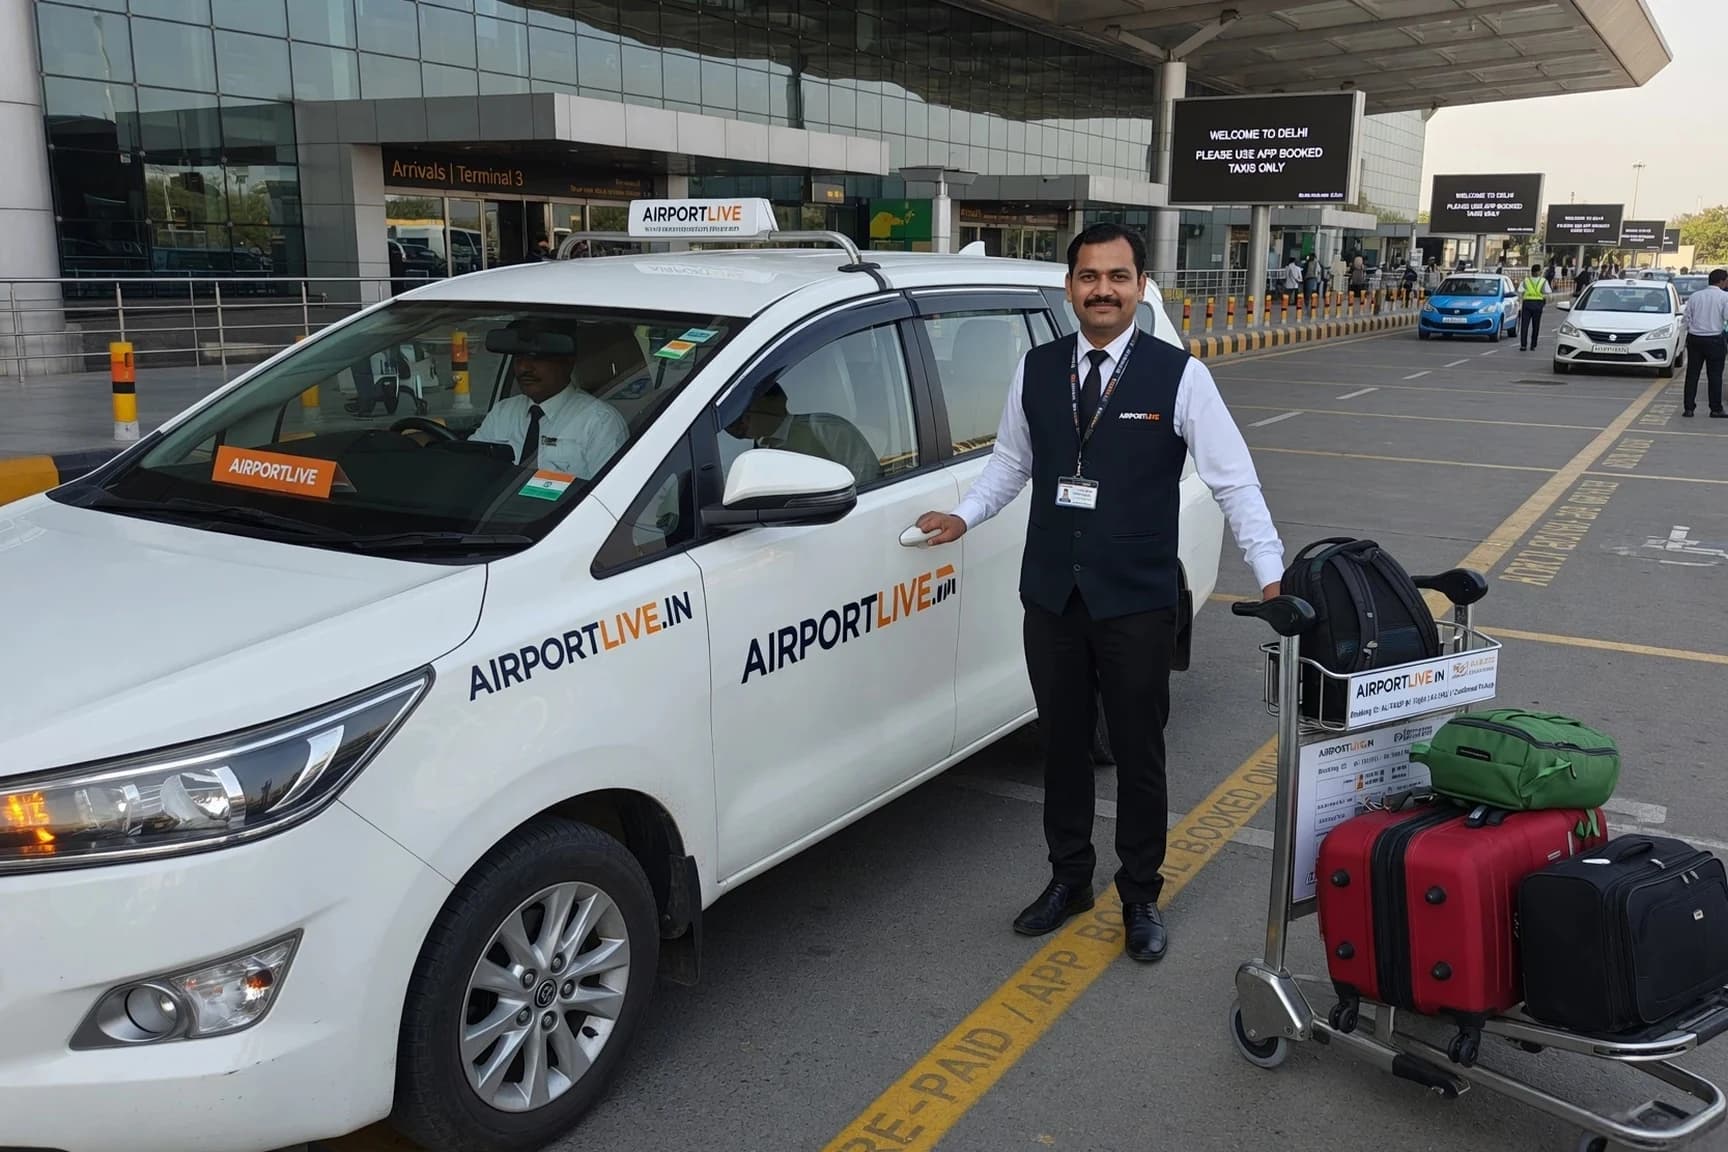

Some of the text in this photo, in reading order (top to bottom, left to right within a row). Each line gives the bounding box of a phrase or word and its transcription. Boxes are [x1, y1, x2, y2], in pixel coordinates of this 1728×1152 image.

[1209, 127, 1309, 140] WELCOME TO DELHI
[1195, 147, 1323, 160] PLEASE USE APP BOOKED
[392, 159, 446, 181] Arrivals
[456, 165, 513, 186] Terminal
[515, 170, 524, 187] 3
[1228, 162, 1285, 174] TAXIS ONLY
[642, 205, 742, 222] AIRPORTLIVE
[229, 458, 318, 484] AIRPORTLIVE
[469, 591, 693, 702] AIRPORTLIVE.IN
[1016, 950, 1089, 1005] APP
[1169, 788, 1262, 854] BOOKED
